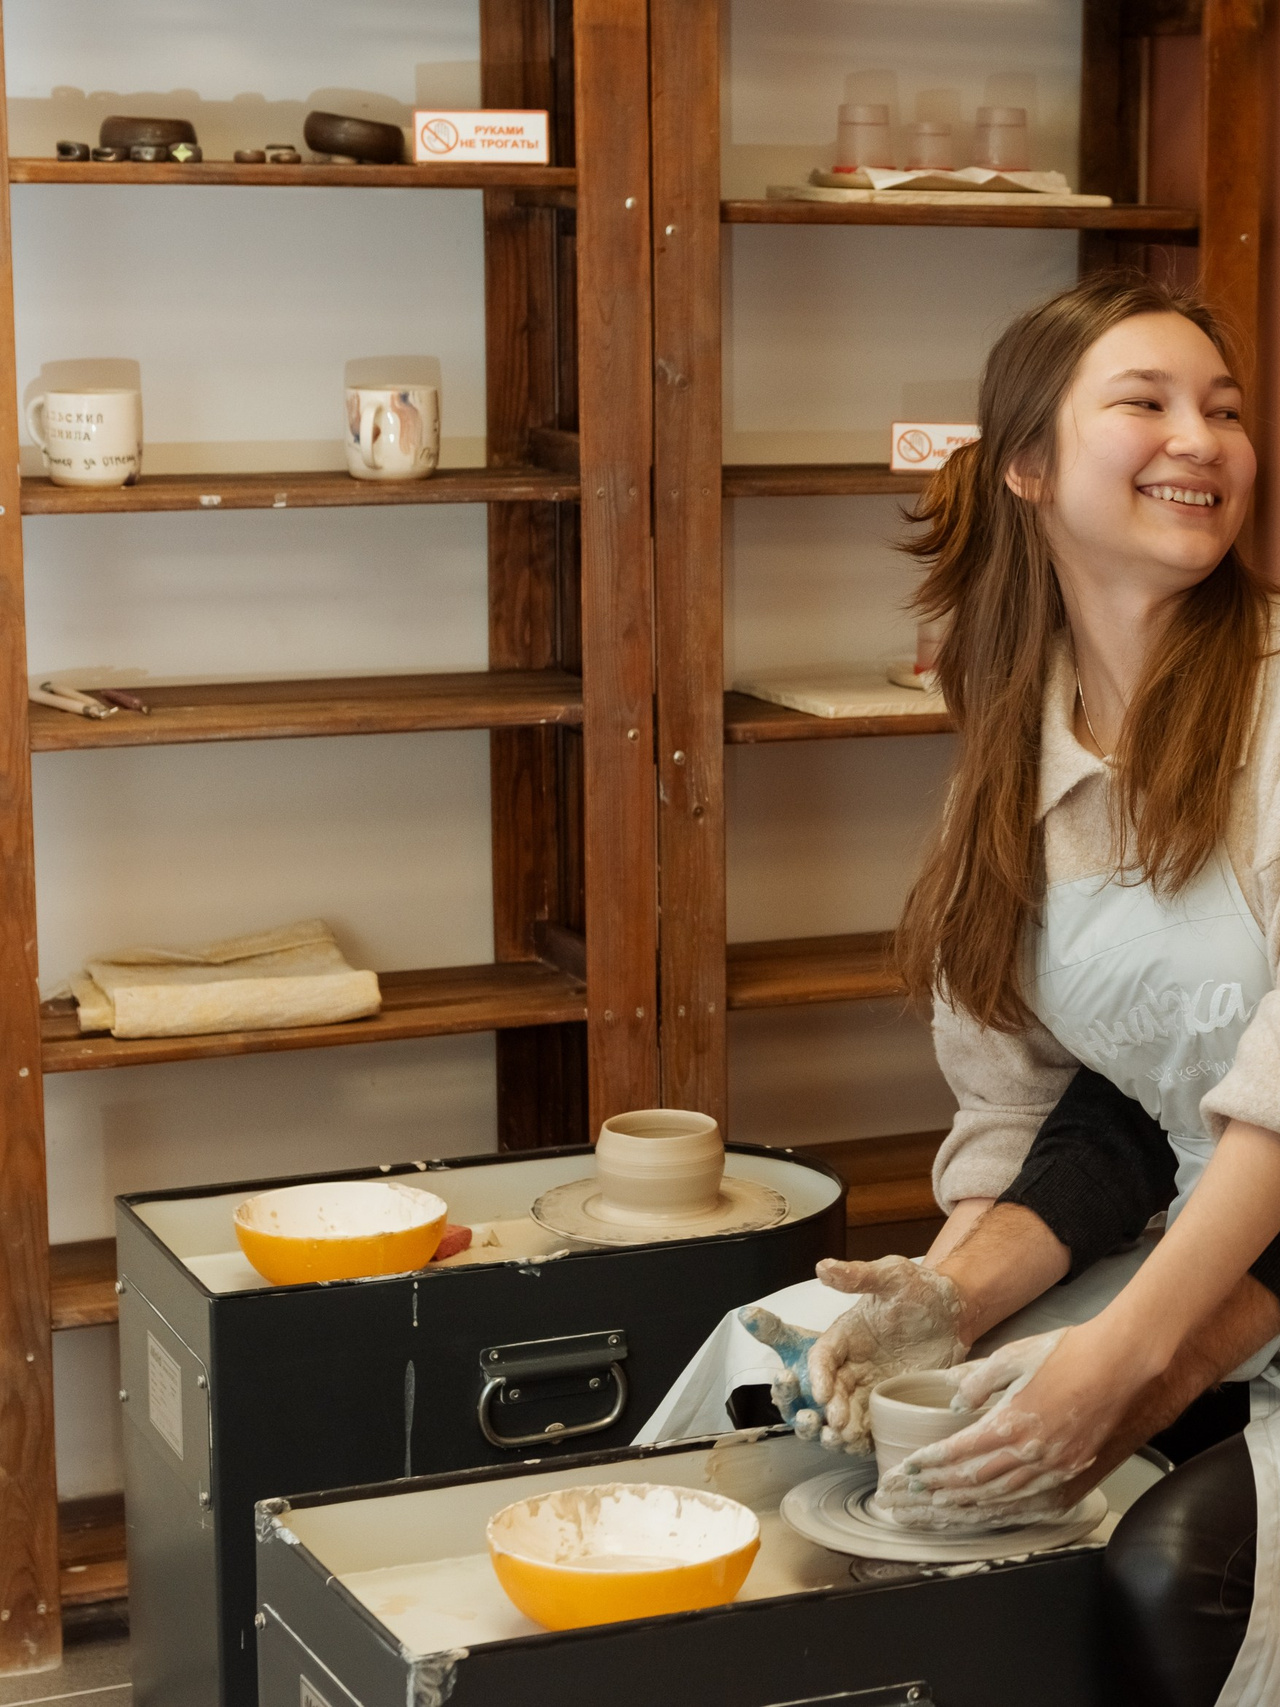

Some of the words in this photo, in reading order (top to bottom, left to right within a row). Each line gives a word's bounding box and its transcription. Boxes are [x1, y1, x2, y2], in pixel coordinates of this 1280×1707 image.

[474, 126, 524, 135] РУКАМИ
[460, 139, 476, 149] НЕ
[481, 139, 539, 149] ТРОГАТЬ!
[932, 449, 948, 458] НЕ
